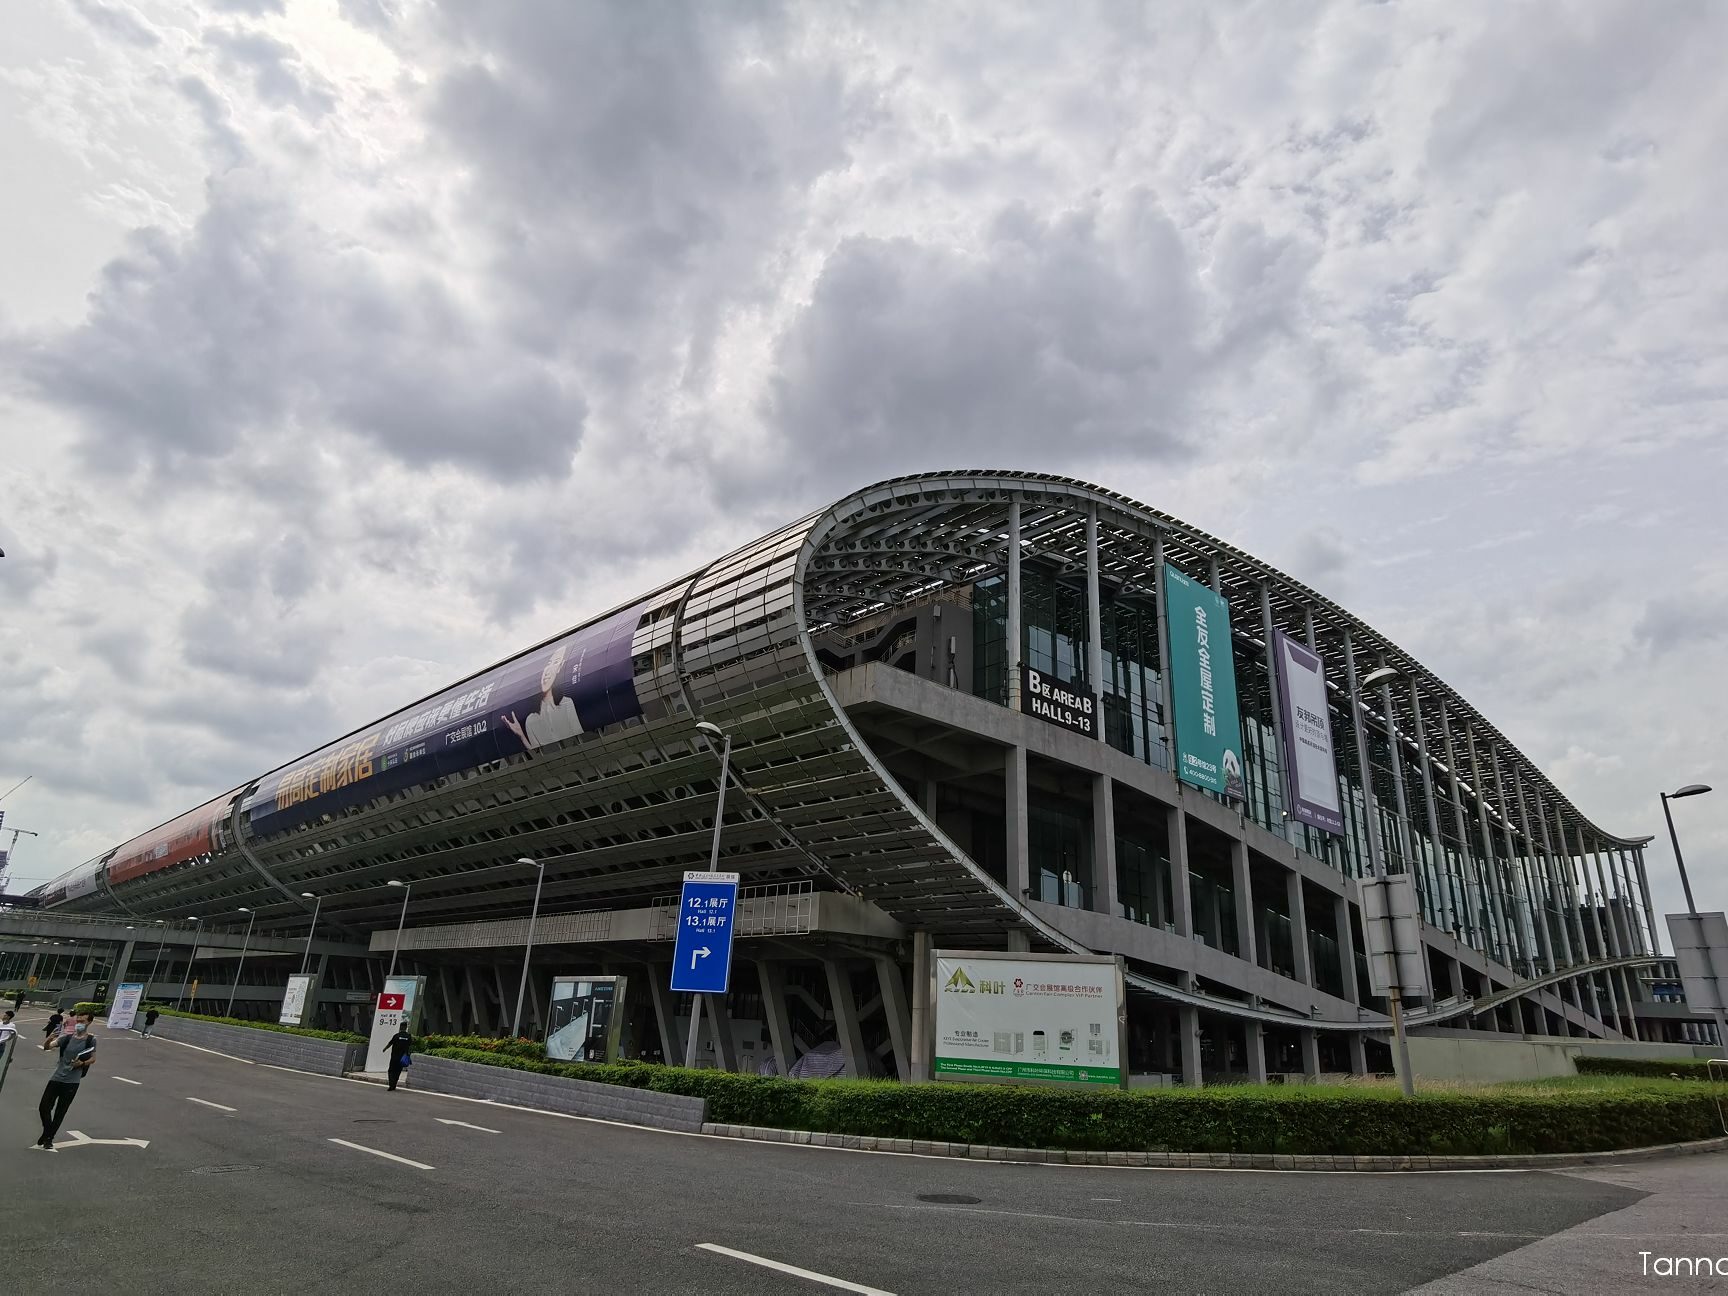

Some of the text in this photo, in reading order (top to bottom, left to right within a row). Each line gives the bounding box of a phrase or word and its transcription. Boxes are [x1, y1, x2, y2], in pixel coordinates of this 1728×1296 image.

[1194, 605, 1216, 737] 全友全屋定制
[1053, 687, 1083, 712] AREA
[1083, 696, 1093, 714] B
[1031, 697, 1091, 732] HALL 9-13
[688, 897, 729, 908] 12.1展厅
[686, 915, 727, 927] 13.1展厅
[979, 980, 1006, 995] 科叶
[379, 1018, 398, 1026] 9-13
